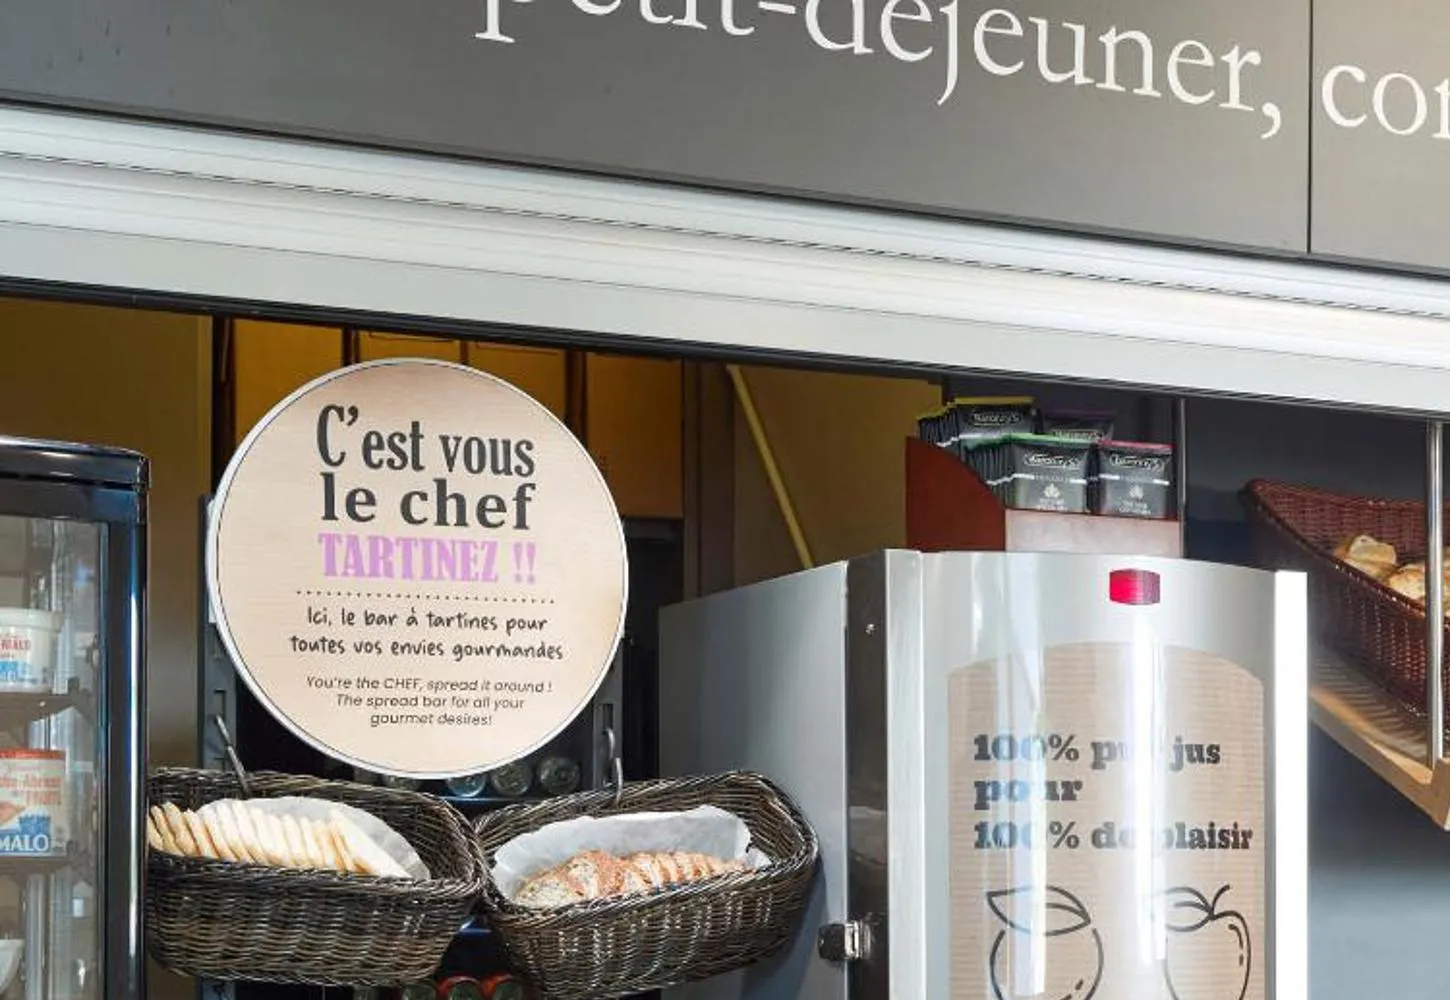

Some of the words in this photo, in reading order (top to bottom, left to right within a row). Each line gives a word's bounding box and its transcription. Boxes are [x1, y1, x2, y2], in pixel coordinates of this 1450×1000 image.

[316, 403, 426, 472] C’est
[438, 434, 536, 478] vous
[319, 471, 377, 523] le
[400, 478, 537, 531] chef
[317, 532, 499, 583] TARTINEZ
[511, 540, 538, 584] !!
[307, 605, 332, 627] Ici,
[341, 607, 356, 627] le
[364, 608, 398, 627] bar
[405, 606, 419, 627] à
[426, 611, 498, 631] tartines
[505, 617, 548, 637] pour
[290, 635, 346, 654] toutes
[353, 640, 383, 655] vos
[390, 639, 444, 656] envies
[452, 641, 563, 662] gourmandes
[306, 675, 353, 689] You're
[356, 676, 380, 689] the
[383, 677, 424, 692] CHEF,
[426, 679, 479, 694] spread
[480, 679, 491, 691] it
[494, 680, 545, 693] around
[337, 693, 363, 707] The
[366, 696, 419, 709] spread
[422, 695, 448, 708] bar
[451, 696, 469, 708] for
[473, 697, 490, 709] all
[494, 699, 525, 711] your
[370, 713, 434, 728] gourmet
[974, 734, 1080, 762] 100%
[1169, 735, 1221, 772] jus
